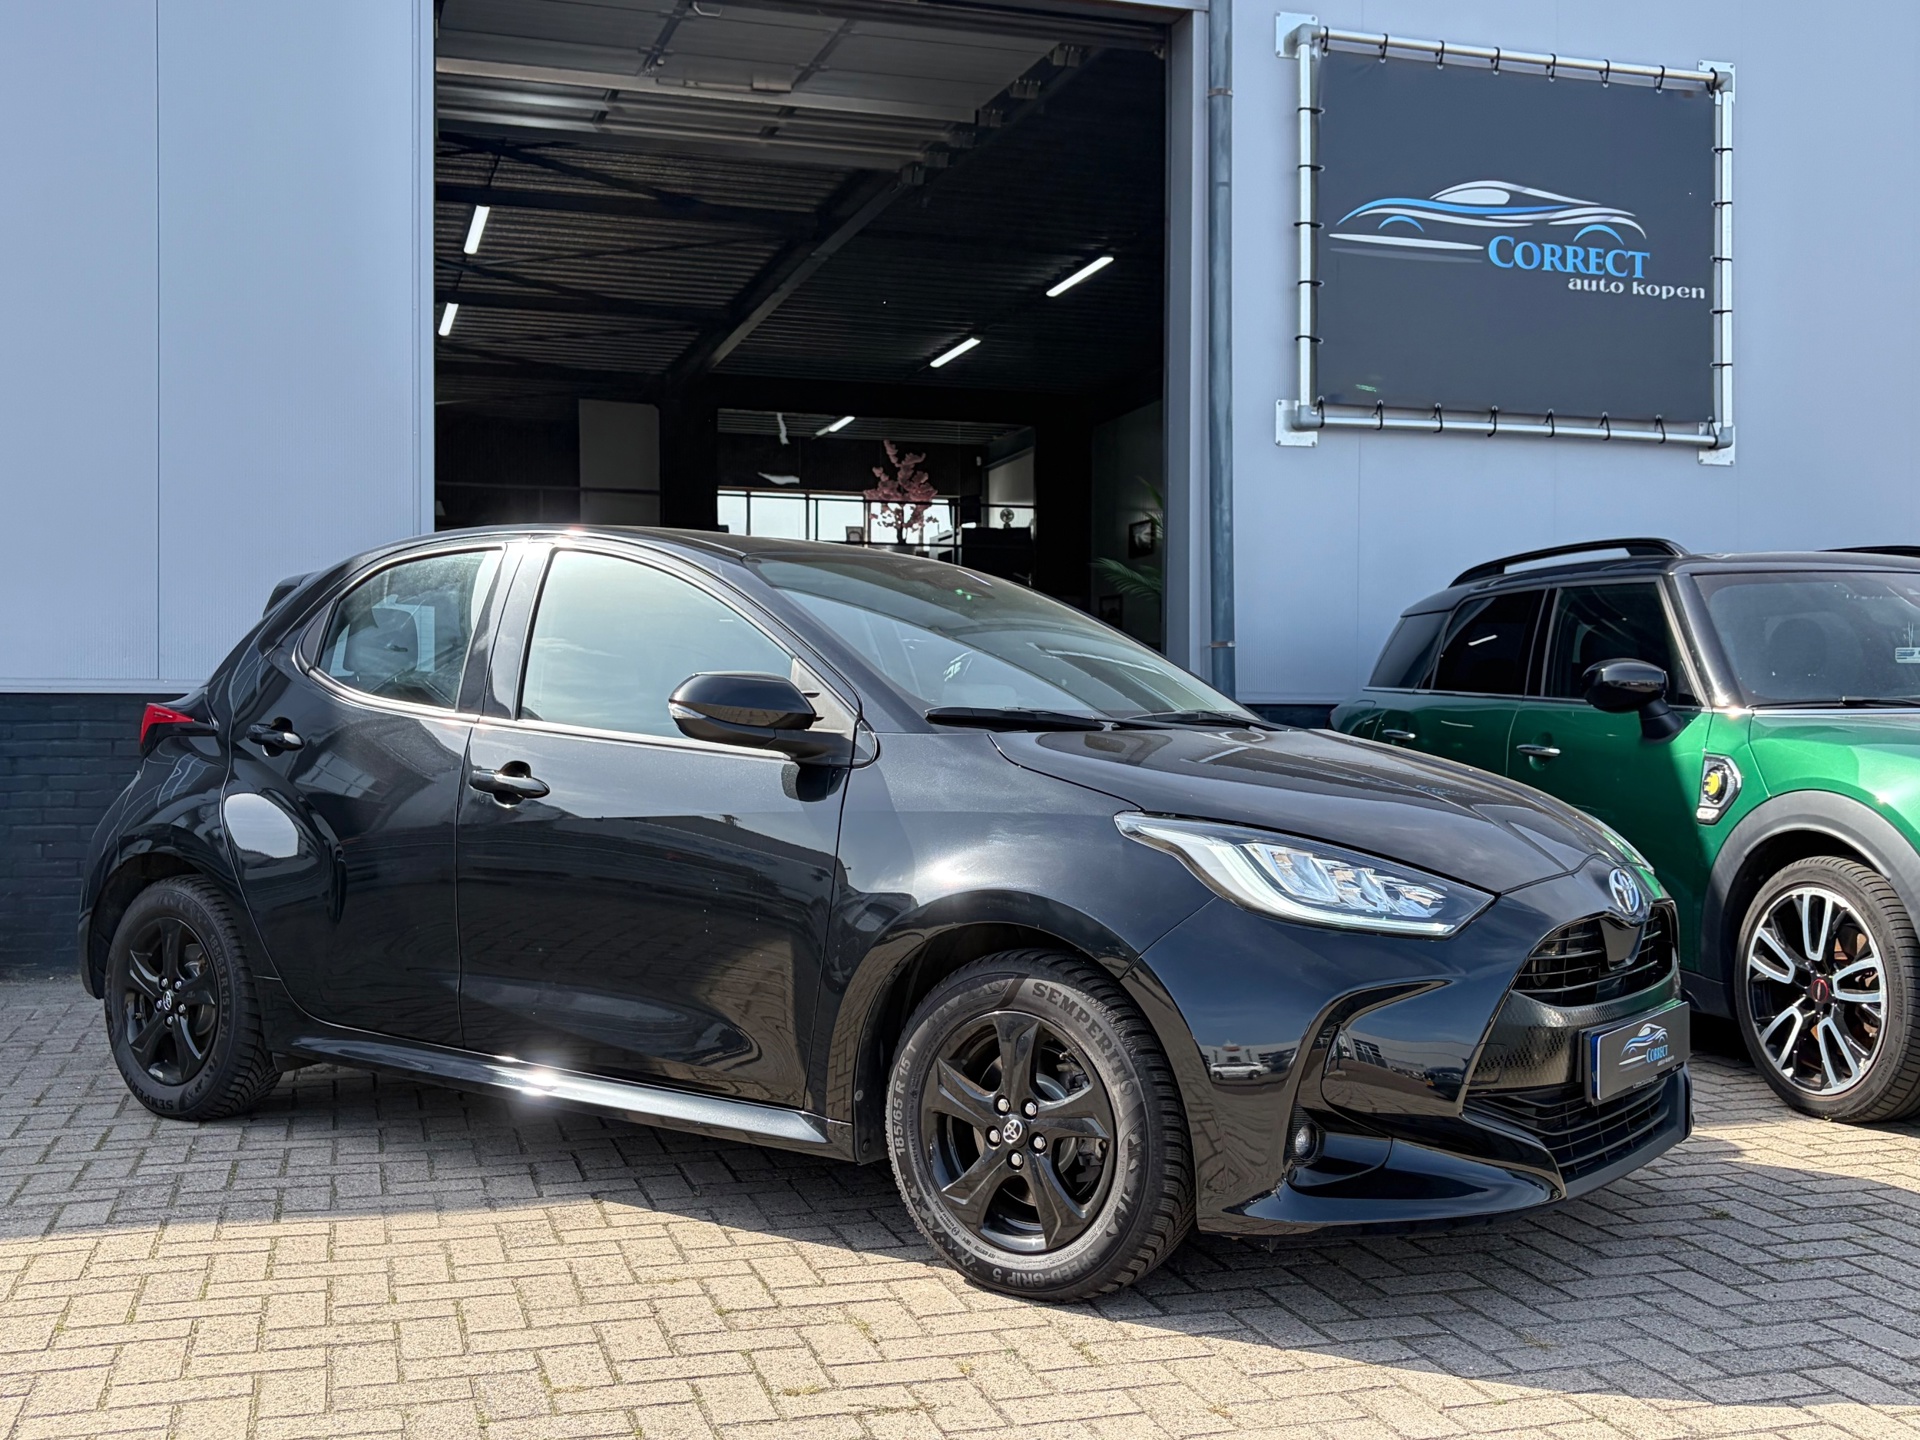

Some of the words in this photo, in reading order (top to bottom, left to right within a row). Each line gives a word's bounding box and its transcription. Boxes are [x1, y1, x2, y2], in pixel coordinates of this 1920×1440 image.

[1488, 235, 1650, 279] CORRECT
[1568, 277, 1625, 294] auto
[1632, 281, 1706, 299] kopen
[1032, 982, 1134, 1081] SEMPERIT
[899, 1057, 911, 1076] 15
[894, 1080, 906, 1095] R
[893, 1097, 906, 1156] 185/65
[992, 1268, 1002, 1282] 5
[1006, 1248, 1100, 1288] SPEED-GRIP
